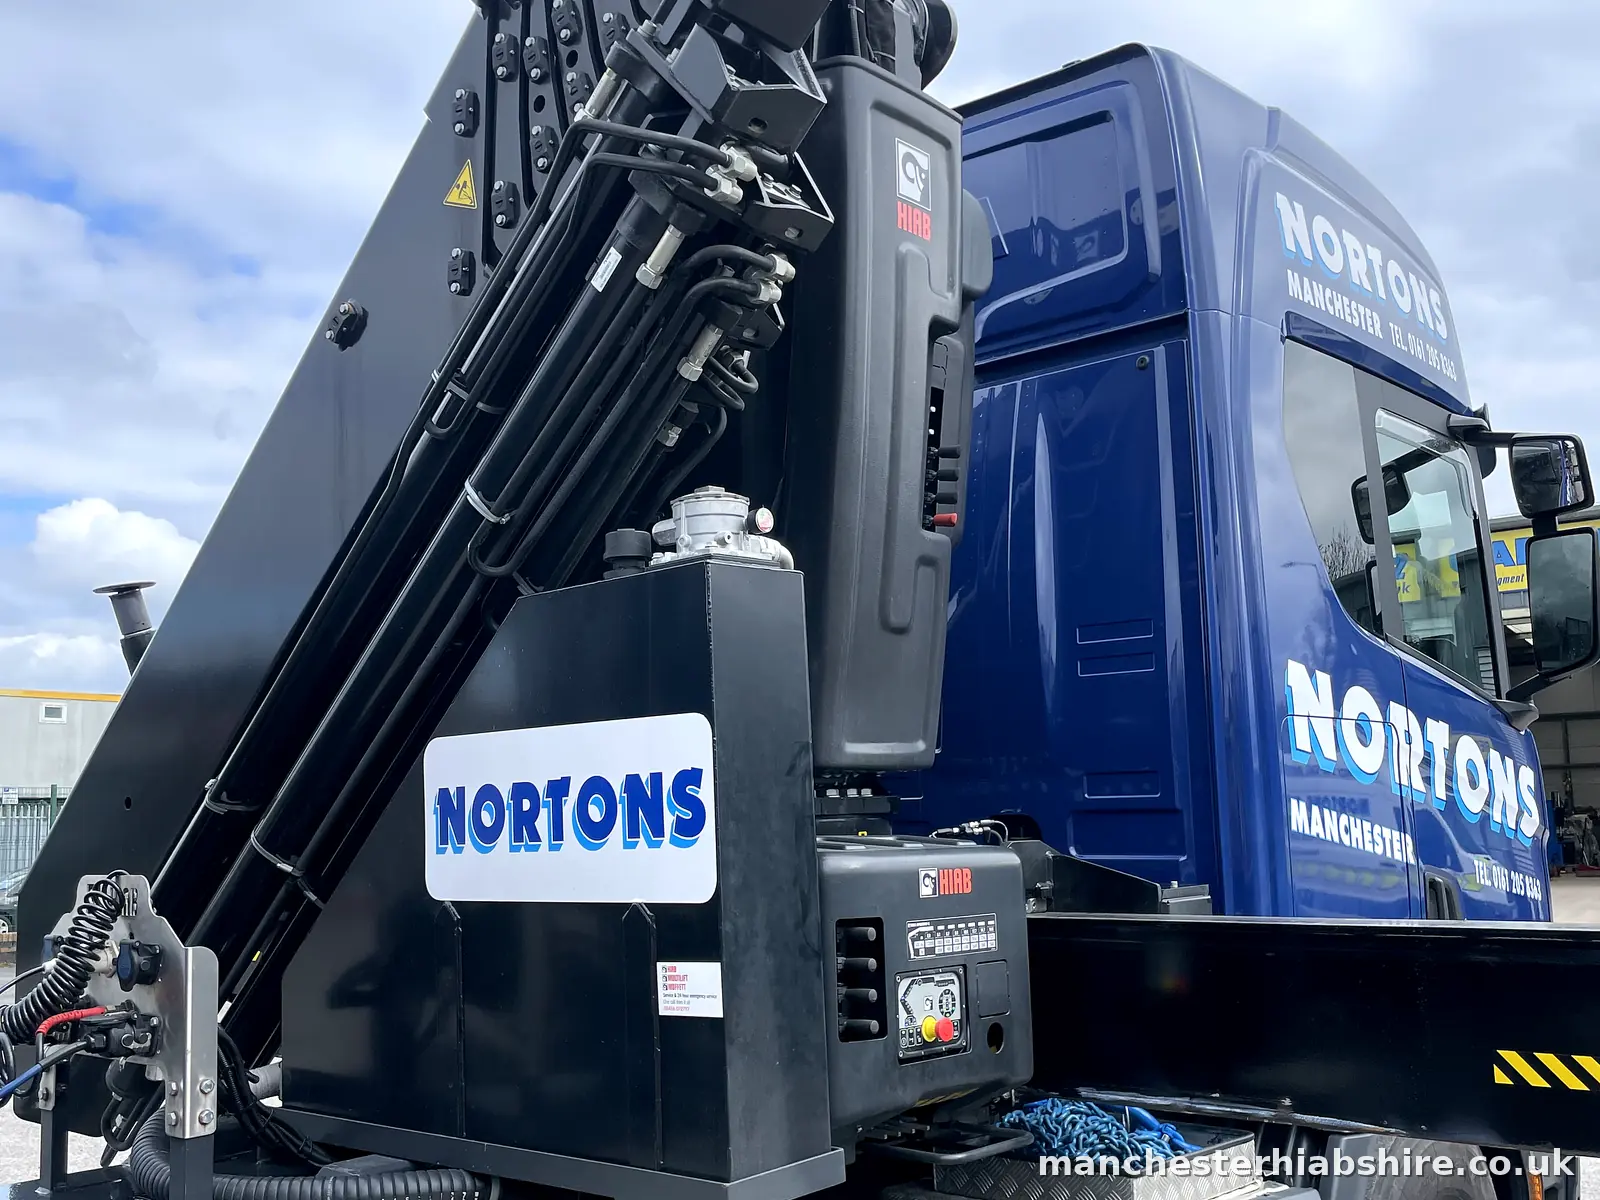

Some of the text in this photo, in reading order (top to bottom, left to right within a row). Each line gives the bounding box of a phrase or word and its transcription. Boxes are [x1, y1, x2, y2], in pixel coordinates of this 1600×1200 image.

[897, 200, 931, 241] HIAB
[1274, 192, 1448, 345] NORTONS
[1287, 269, 1383, 339] MANCHESTER
[1389, 322, 1407, 352] TEL.
[1408, 332, 1426, 362] 0161
[1426, 343, 1440, 371] 205
[1284, 659, 1540, 847] NORTONS
[433, 767, 706, 854] NORTONS
[1290, 798, 1416, 865] MANCHESTER
[1474, 859, 1491, 887] TEL.
[1492, 865, 1509, 893] 0161
[1510, 870, 1524, 897] 205
[939, 868, 972, 895] HIAB
